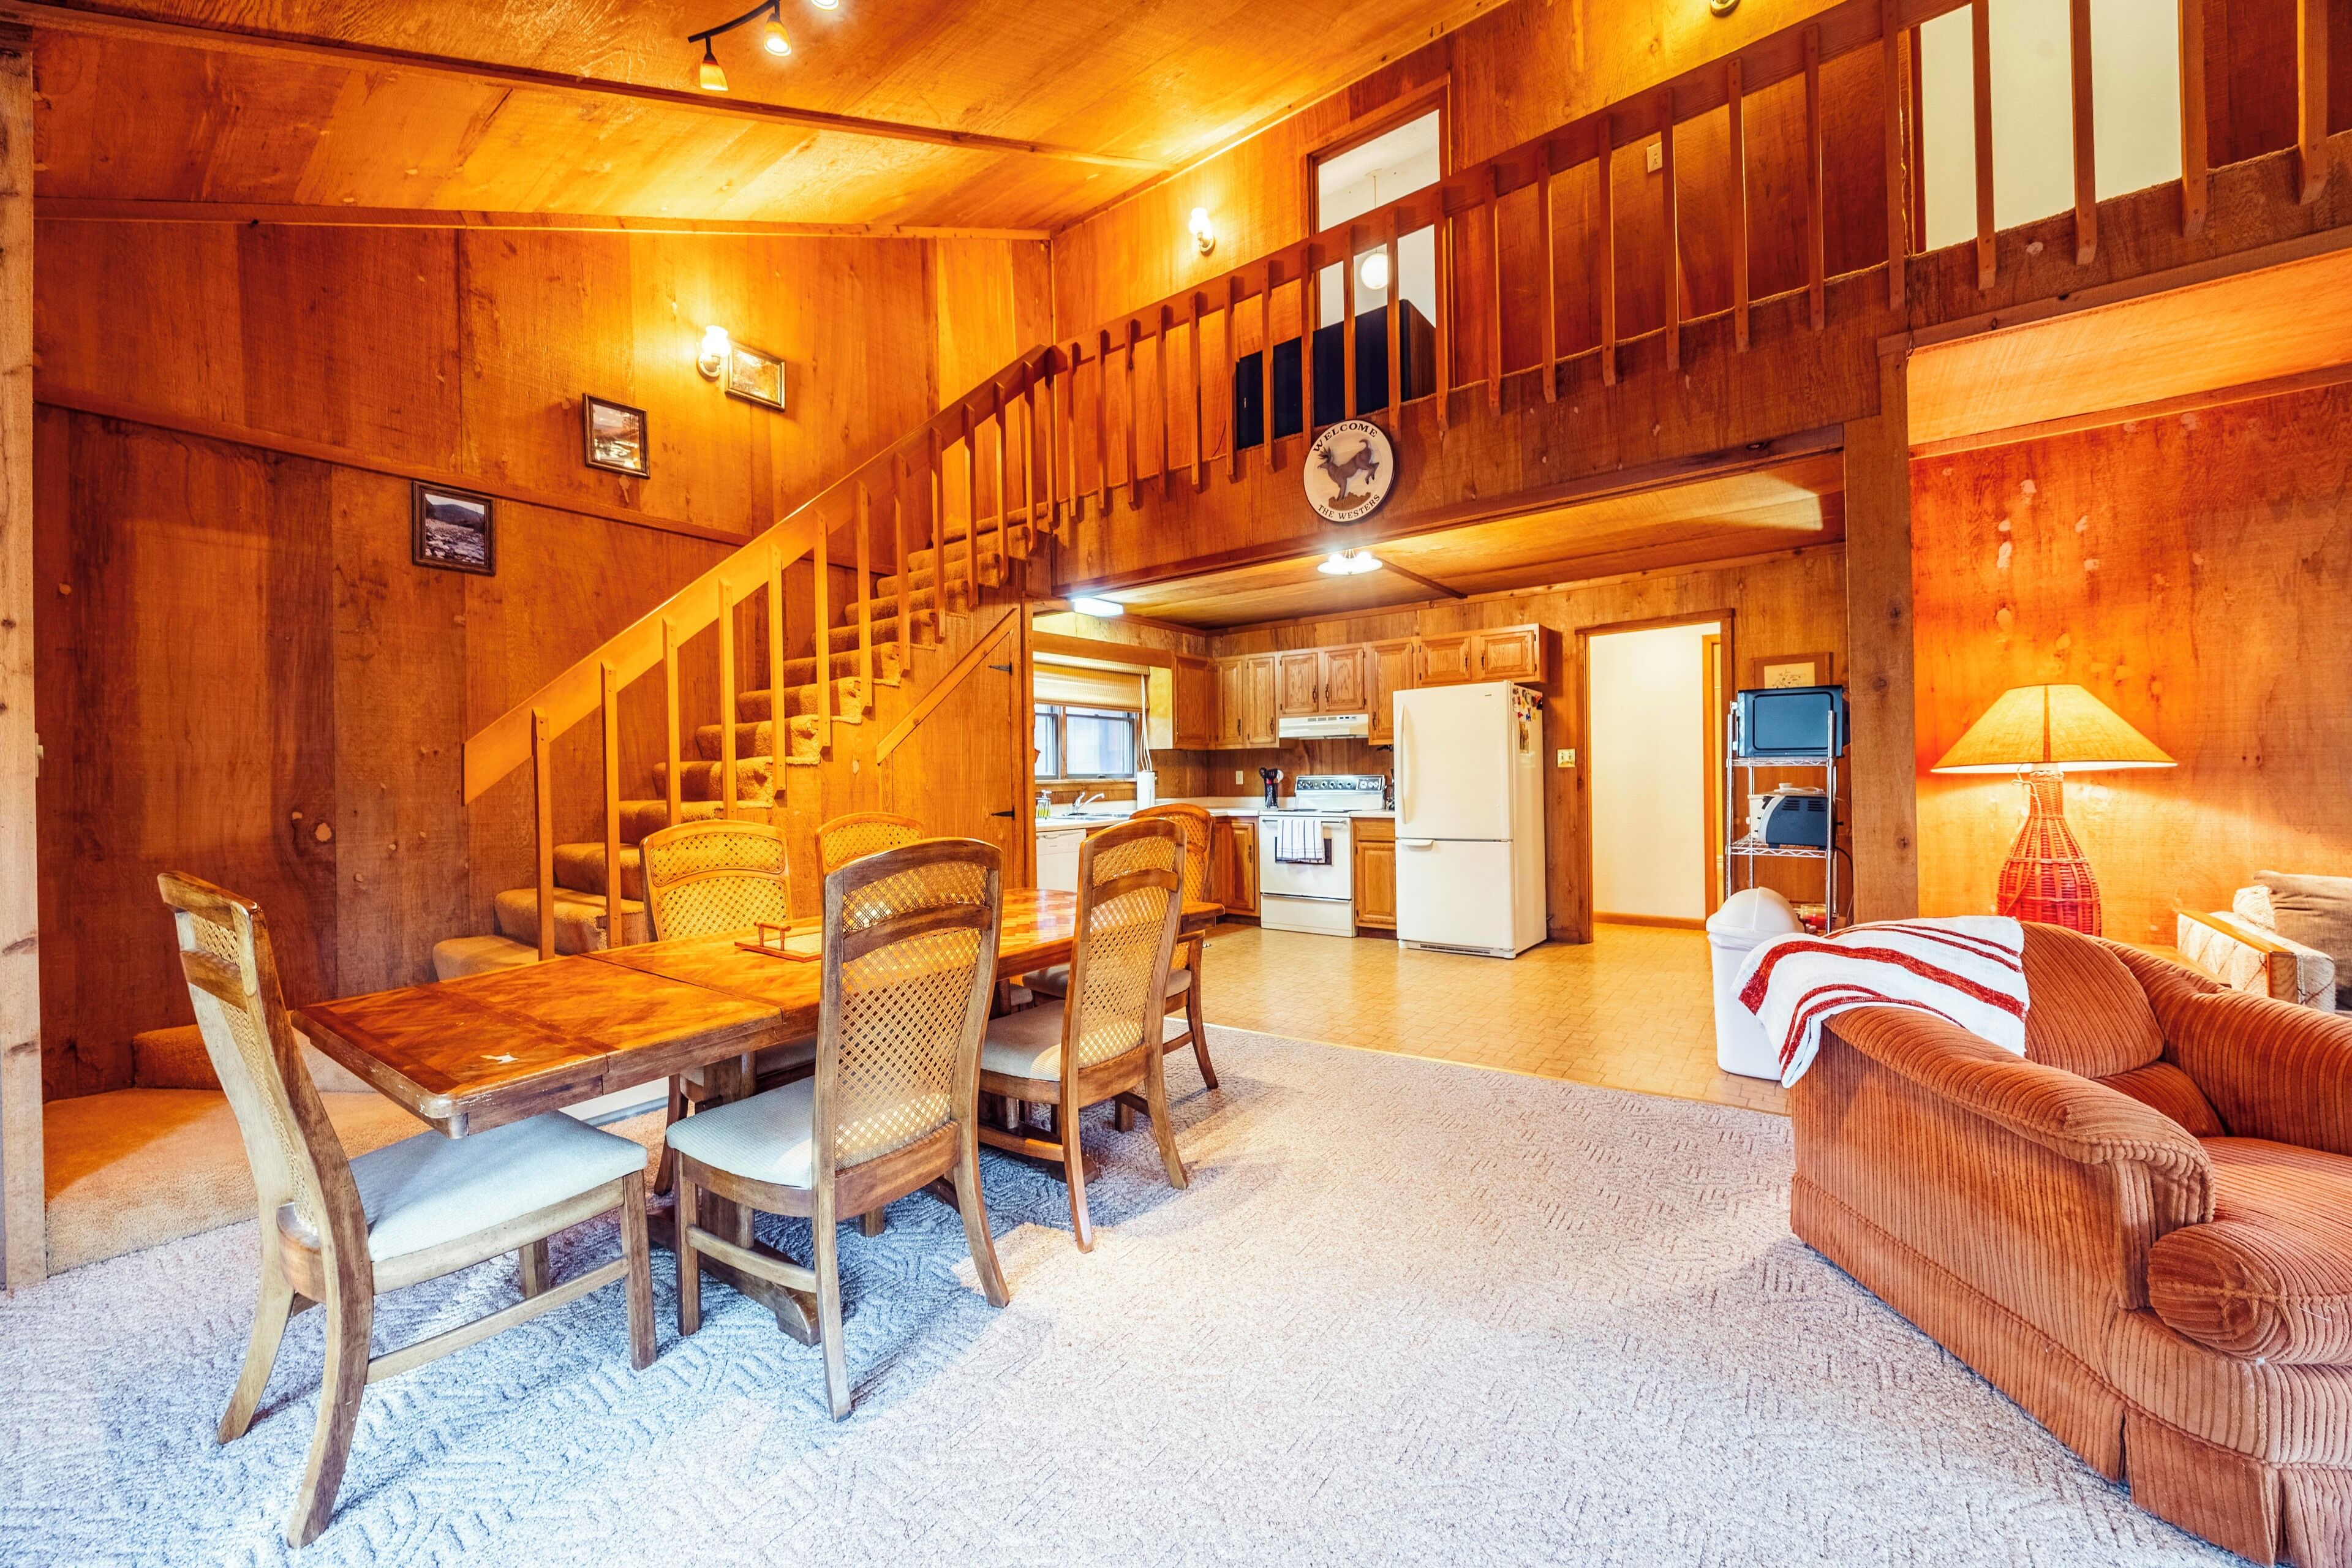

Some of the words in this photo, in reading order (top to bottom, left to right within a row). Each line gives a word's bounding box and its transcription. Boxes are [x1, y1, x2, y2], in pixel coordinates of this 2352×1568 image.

[1313, 423, 1378, 452] WELCOME
[1318, 505, 1334, 518] THE
[1338, 494, 1380, 519] WESTERS
